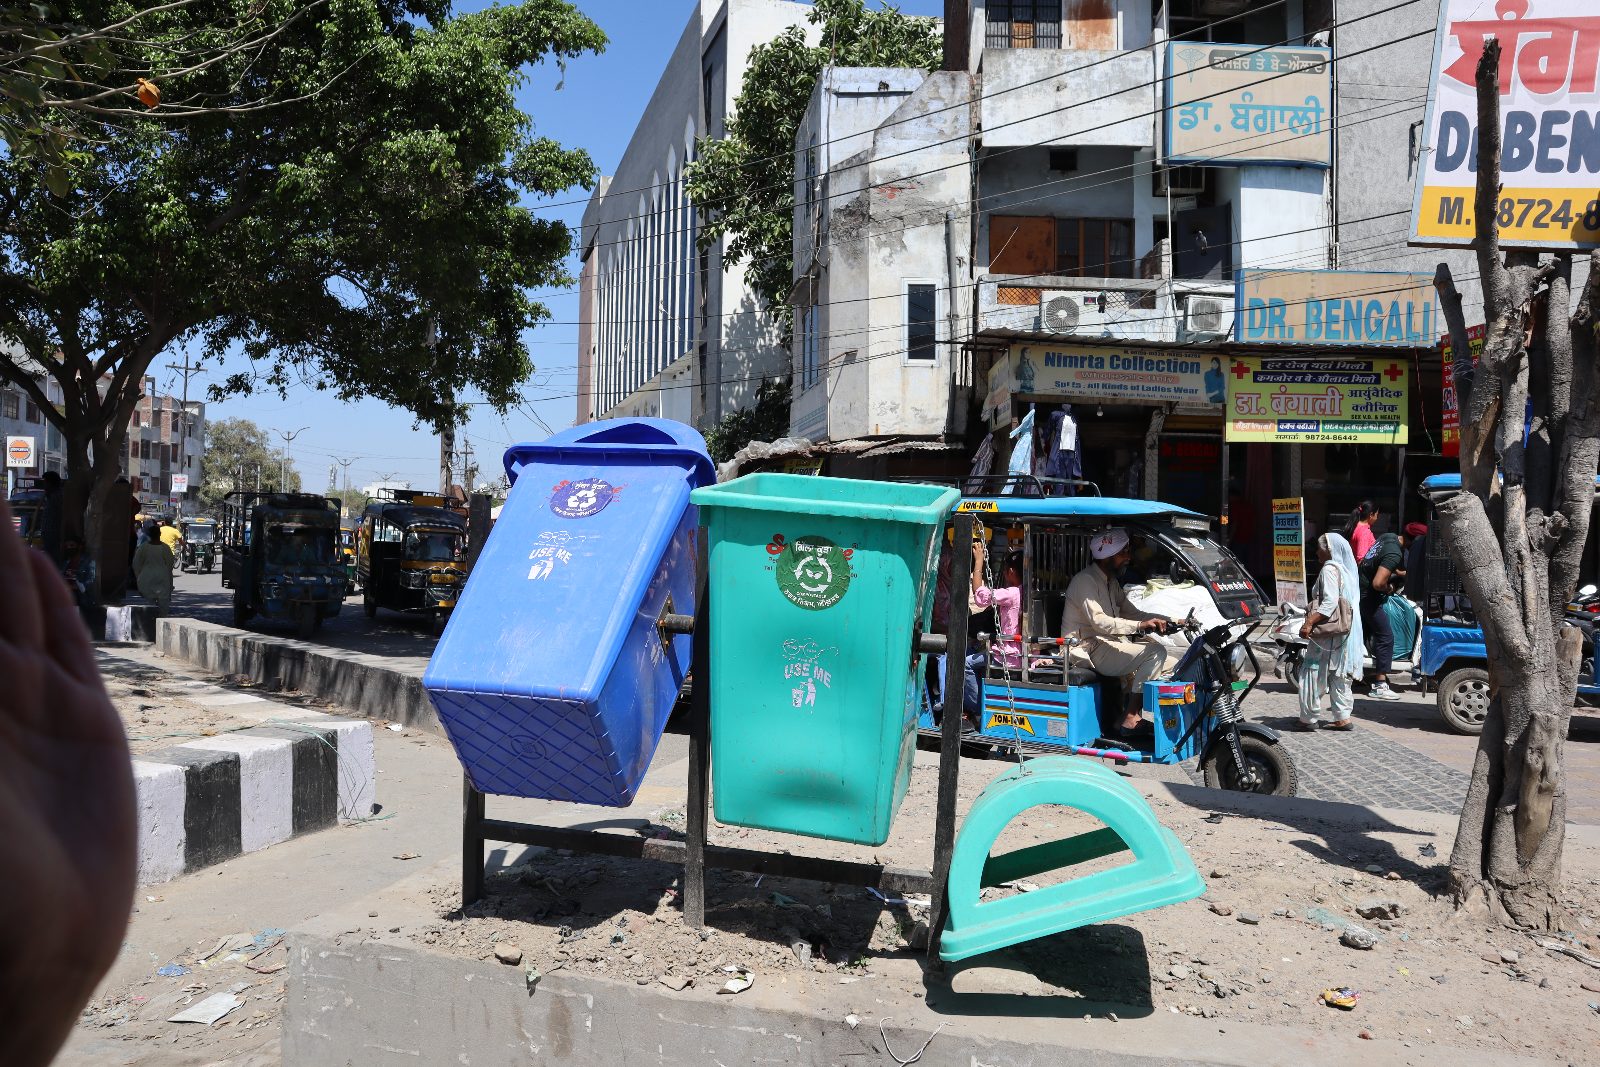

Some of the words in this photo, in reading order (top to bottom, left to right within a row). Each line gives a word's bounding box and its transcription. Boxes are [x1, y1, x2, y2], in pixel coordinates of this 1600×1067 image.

[1256, 54, 1266, 71] ਤੇ
[1178, 101, 1222, 133] ਡਾ.
[1229, 91, 1325, 135] ਬੰਗਾਲੀ
[1434, 110, 1478, 173] D
[1248, 297, 1295, 339] DR.
[1305, 299, 1431, 342] BENGALI
[1044, 351, 1105, 370] Nimrta
[1109, 353, 1201, 375] Collection
[1101, 382, 1129, 391] Kinds
[1141, 384, 1171, 393] Ladies
[1173, 386, 1199, 395] Wear
[1234, 392, 1267, 416] डा.
[1270, 385, 1344, 416] बंगाली
[963, 501, 994, 510] TOM-TOM
[528, 547, 556, 560] USE
[555, 548, 573, 566] ME
[784, 662, 812, 680] USE
[813, 665, 832, 688] ME
